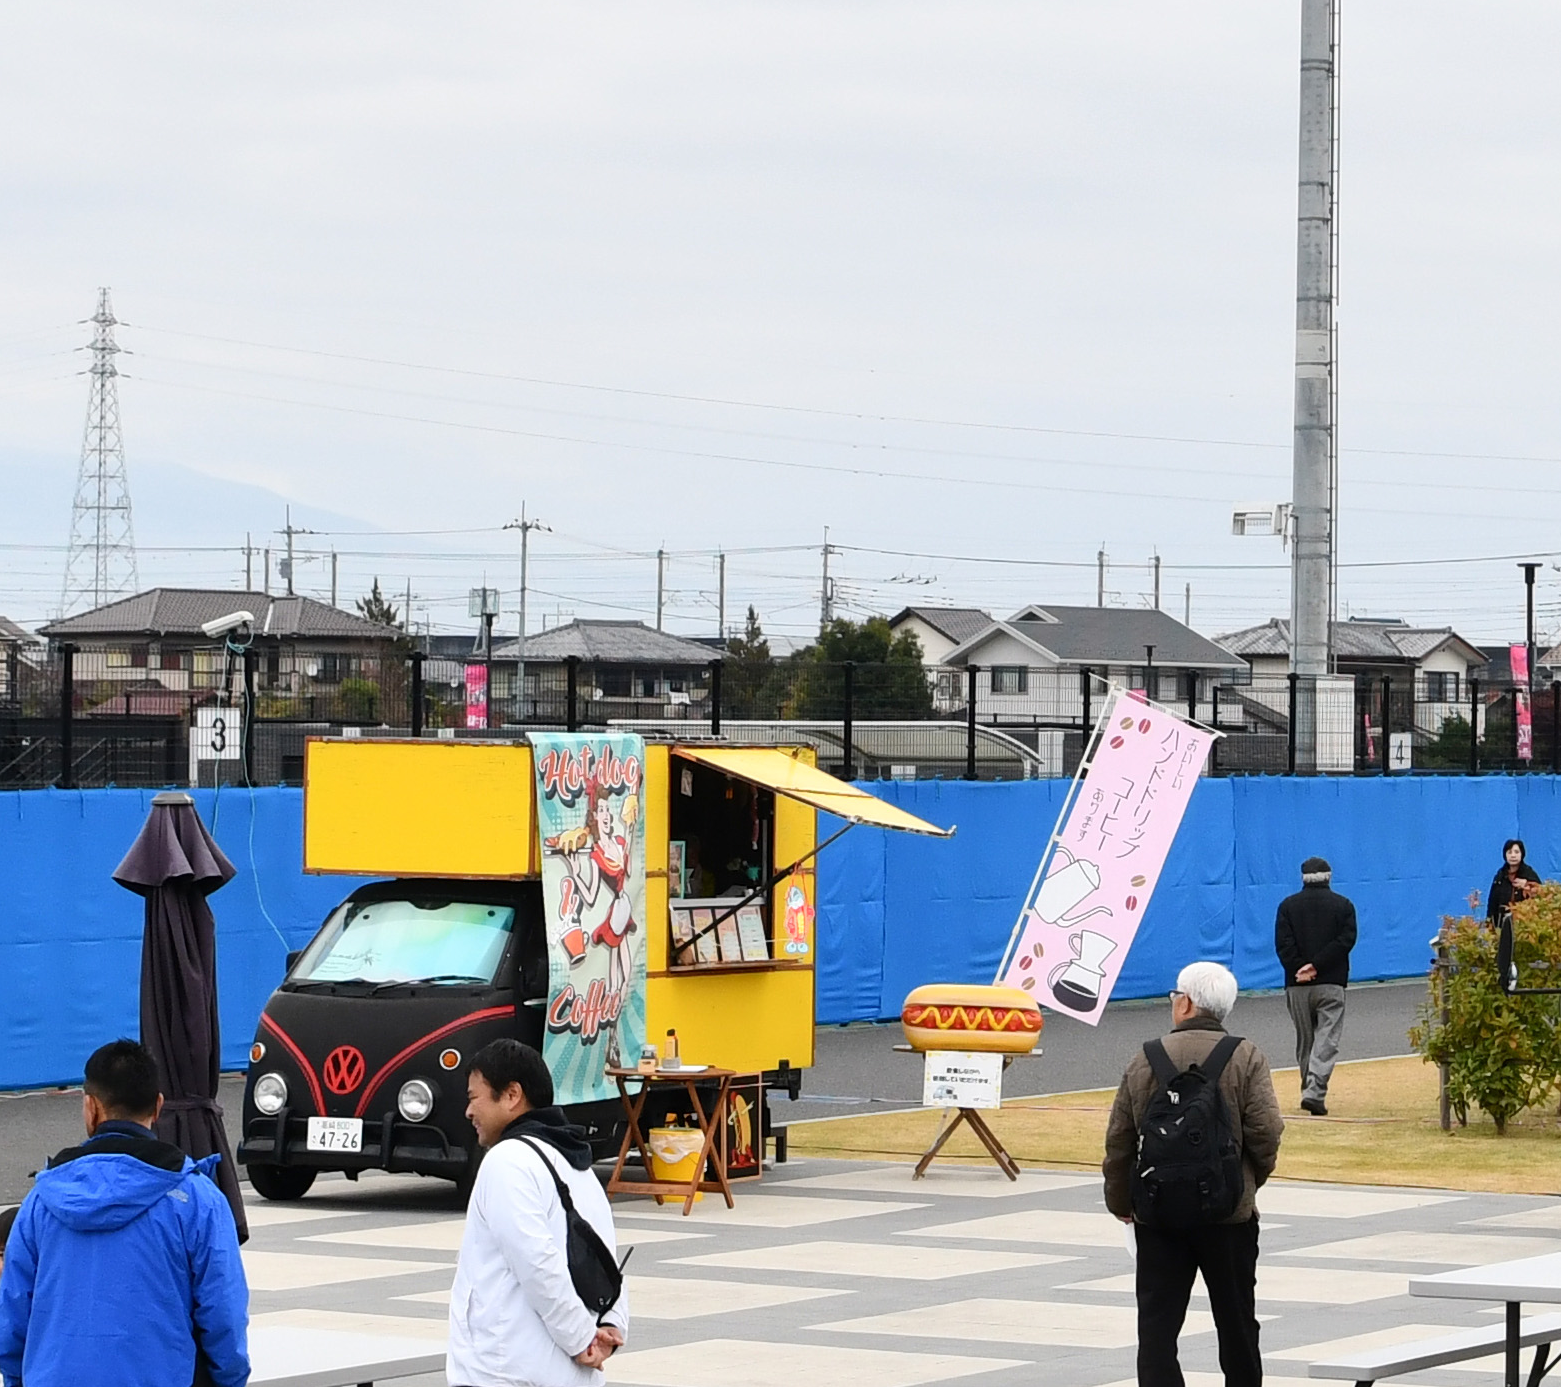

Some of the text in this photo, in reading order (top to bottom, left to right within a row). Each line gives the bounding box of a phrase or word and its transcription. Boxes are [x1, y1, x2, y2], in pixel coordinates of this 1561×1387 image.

[210, 717, 227, 753] 3
[1396, 739, 1405, 765] 4
[540, 745, 641, 800] Hot dog
[1171, 738, 1199, 790] おいしい
[1077, 788, 1105, 842] あります
[1097, 777, 1135, 851] コーヒー
[1116, 728, 1179, 858] ハンドドリップ
[548, 978, 621, 1038] Coffee
[319, 1131, 359, 1149] 47-26
